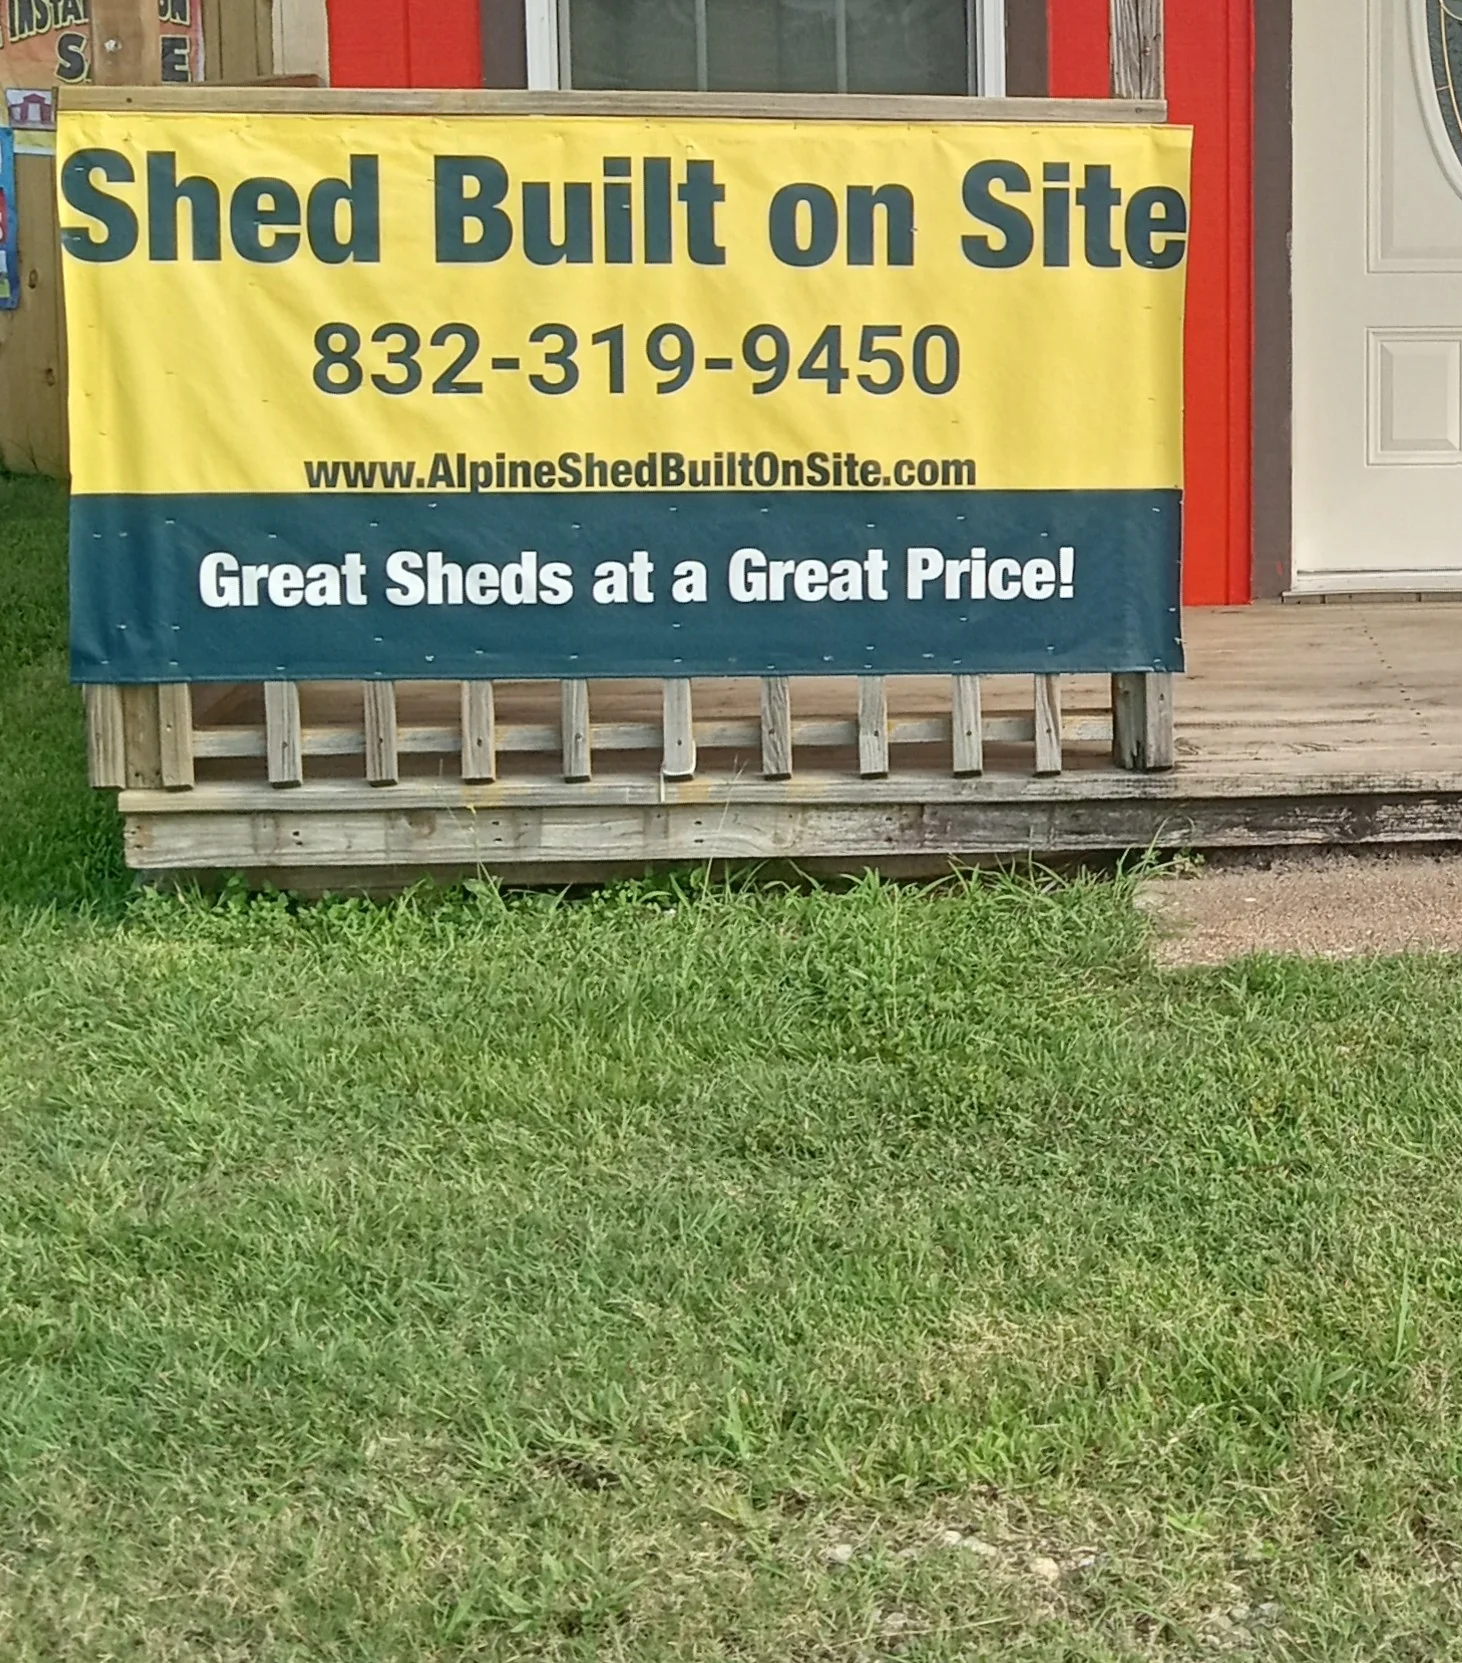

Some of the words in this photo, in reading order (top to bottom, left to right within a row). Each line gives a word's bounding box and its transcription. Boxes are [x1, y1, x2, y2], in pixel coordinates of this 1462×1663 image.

[61, 147, 380, 264] Shed
[433, 154, 726, 267] Built
[768, 181, 915, 269] on
[960, 158, 1188, 270] Site
[312, 322, 960, 395] 832-319-9450
[303, 451, 977, 494] www.AlpineShedBuiltOnSite.com
[199, 551, 368, 608] Great
[385, 550, 574, 607] Sheds
[591, 550, 655, 604] at
[671, 558, 708, 604] a
[727, 547, 889, 603] Great
[906, 546, 1075, 600] Price!
